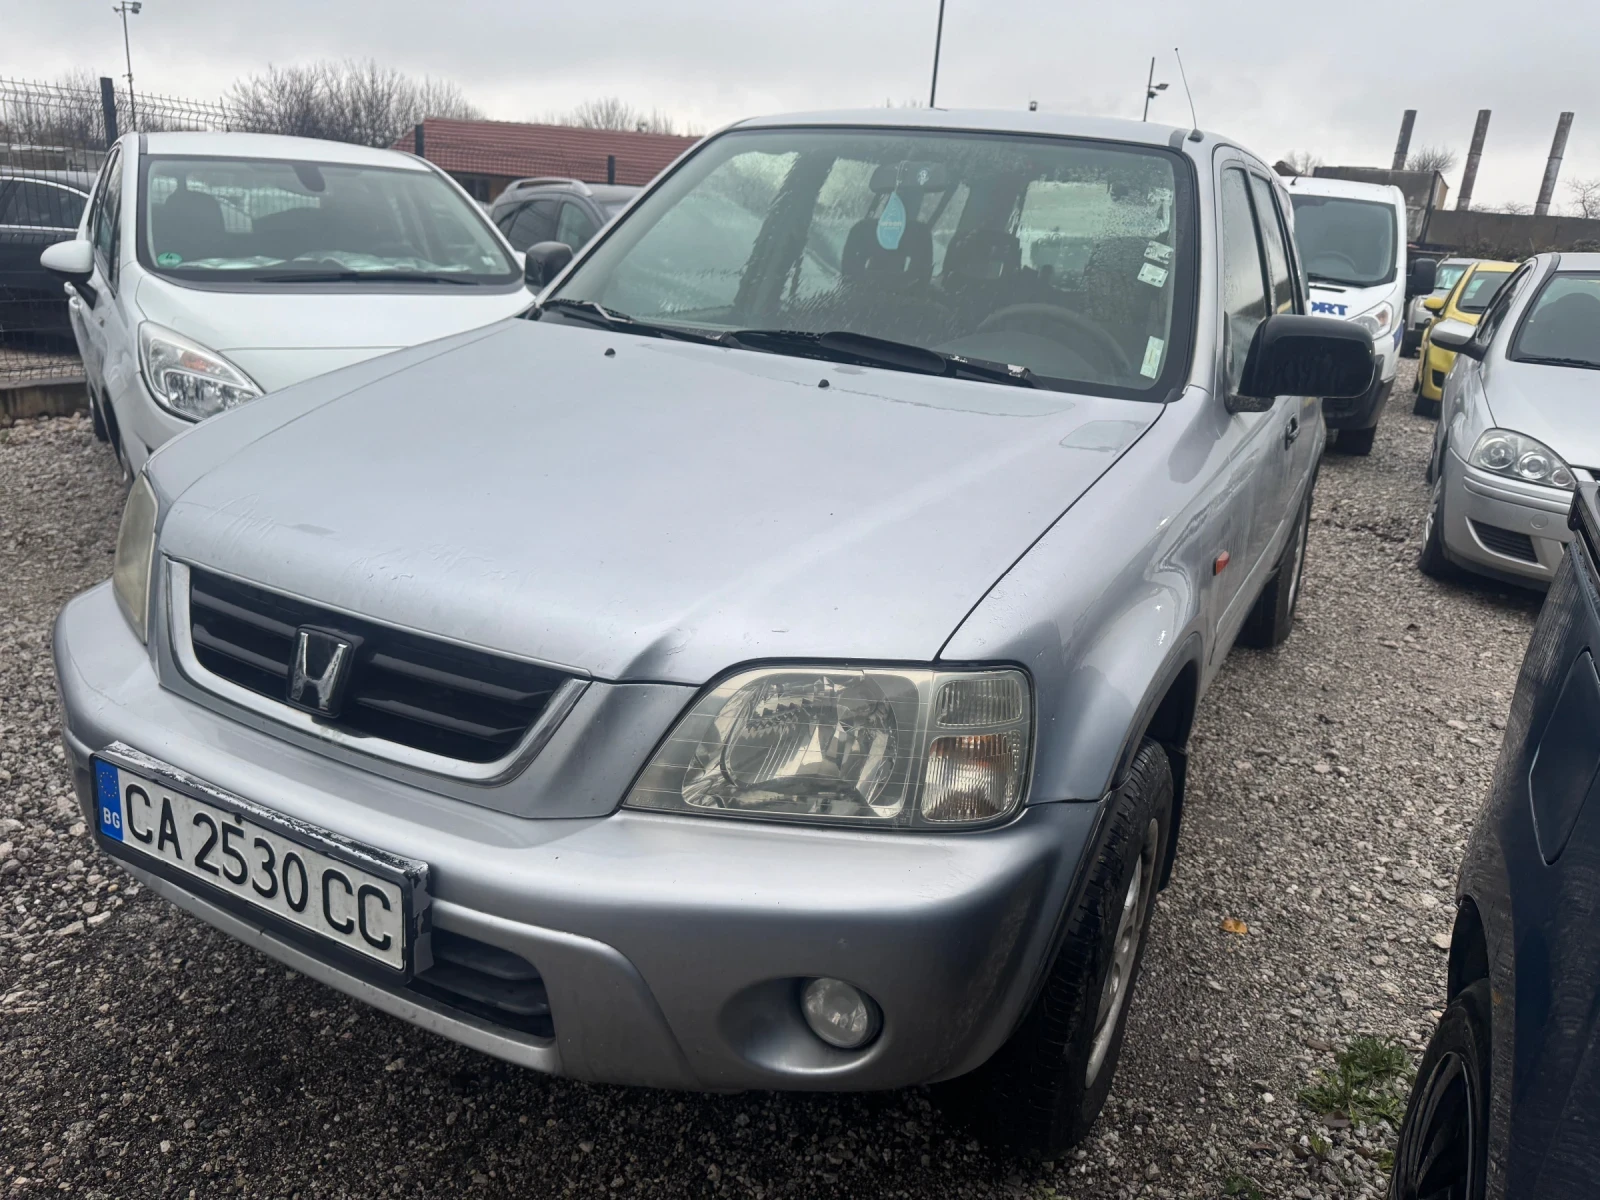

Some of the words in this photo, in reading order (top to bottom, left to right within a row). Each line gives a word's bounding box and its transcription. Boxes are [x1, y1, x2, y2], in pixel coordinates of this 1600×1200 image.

[103, 807, 120, 829] BG
[125, 783, 182, 860] CA
[192, 812, 308, 912] 2530
[322, 868, 391, 951] CC
